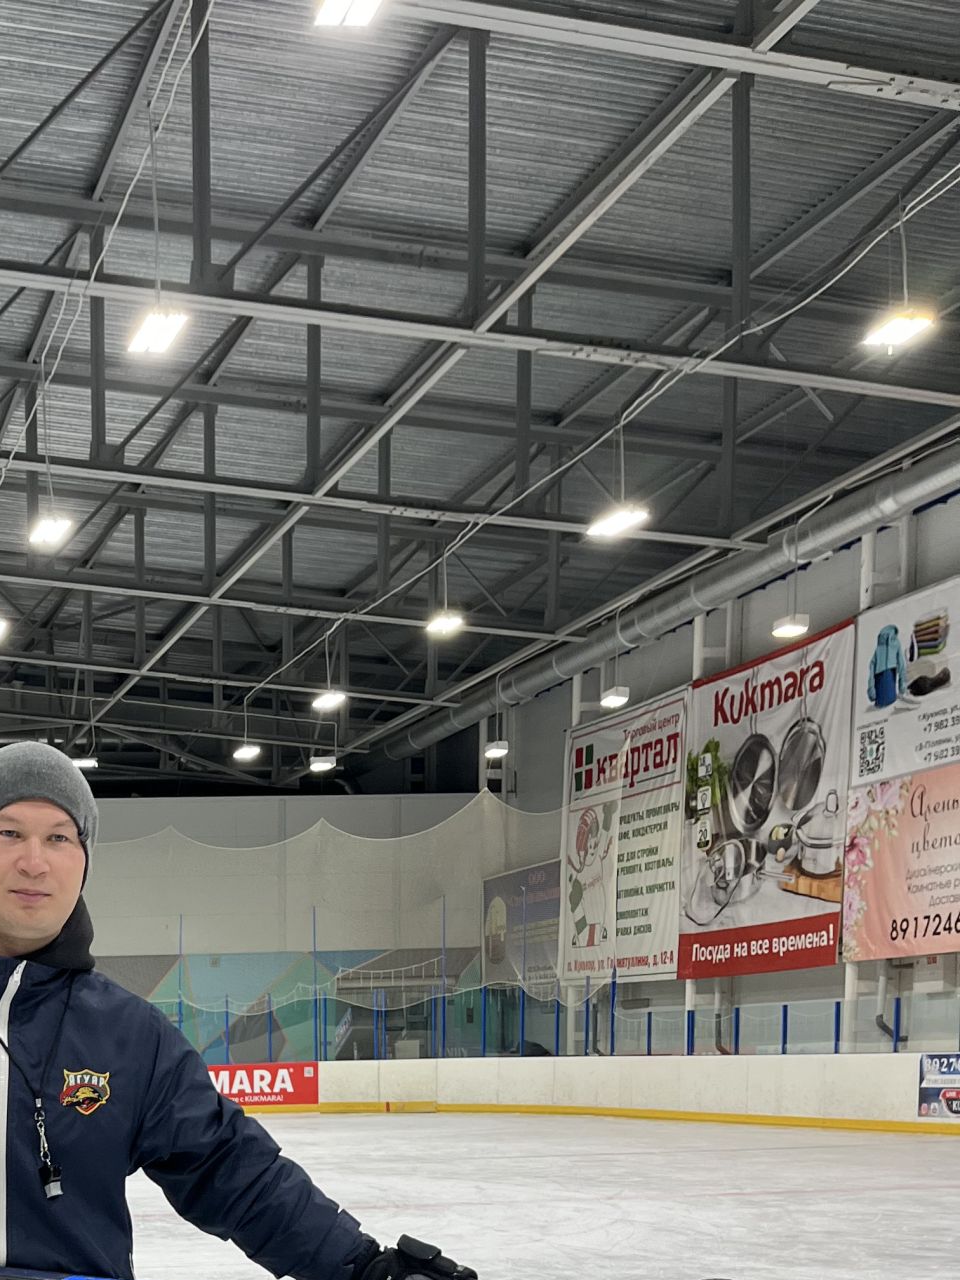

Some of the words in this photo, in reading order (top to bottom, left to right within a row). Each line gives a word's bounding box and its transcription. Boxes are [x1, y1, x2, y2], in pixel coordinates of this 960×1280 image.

[713, 660, 825, 727] Kukmara
[691, 943, 731, 964] Посуда
[733, 941, 748, 958] на
[750, 938, 770, 956] все
[771, 923, 835, 957] времена!
[69, 1074, 105, 1088] ЯГУАР
[244, 1095, 284, 1103] KUKMARA!
